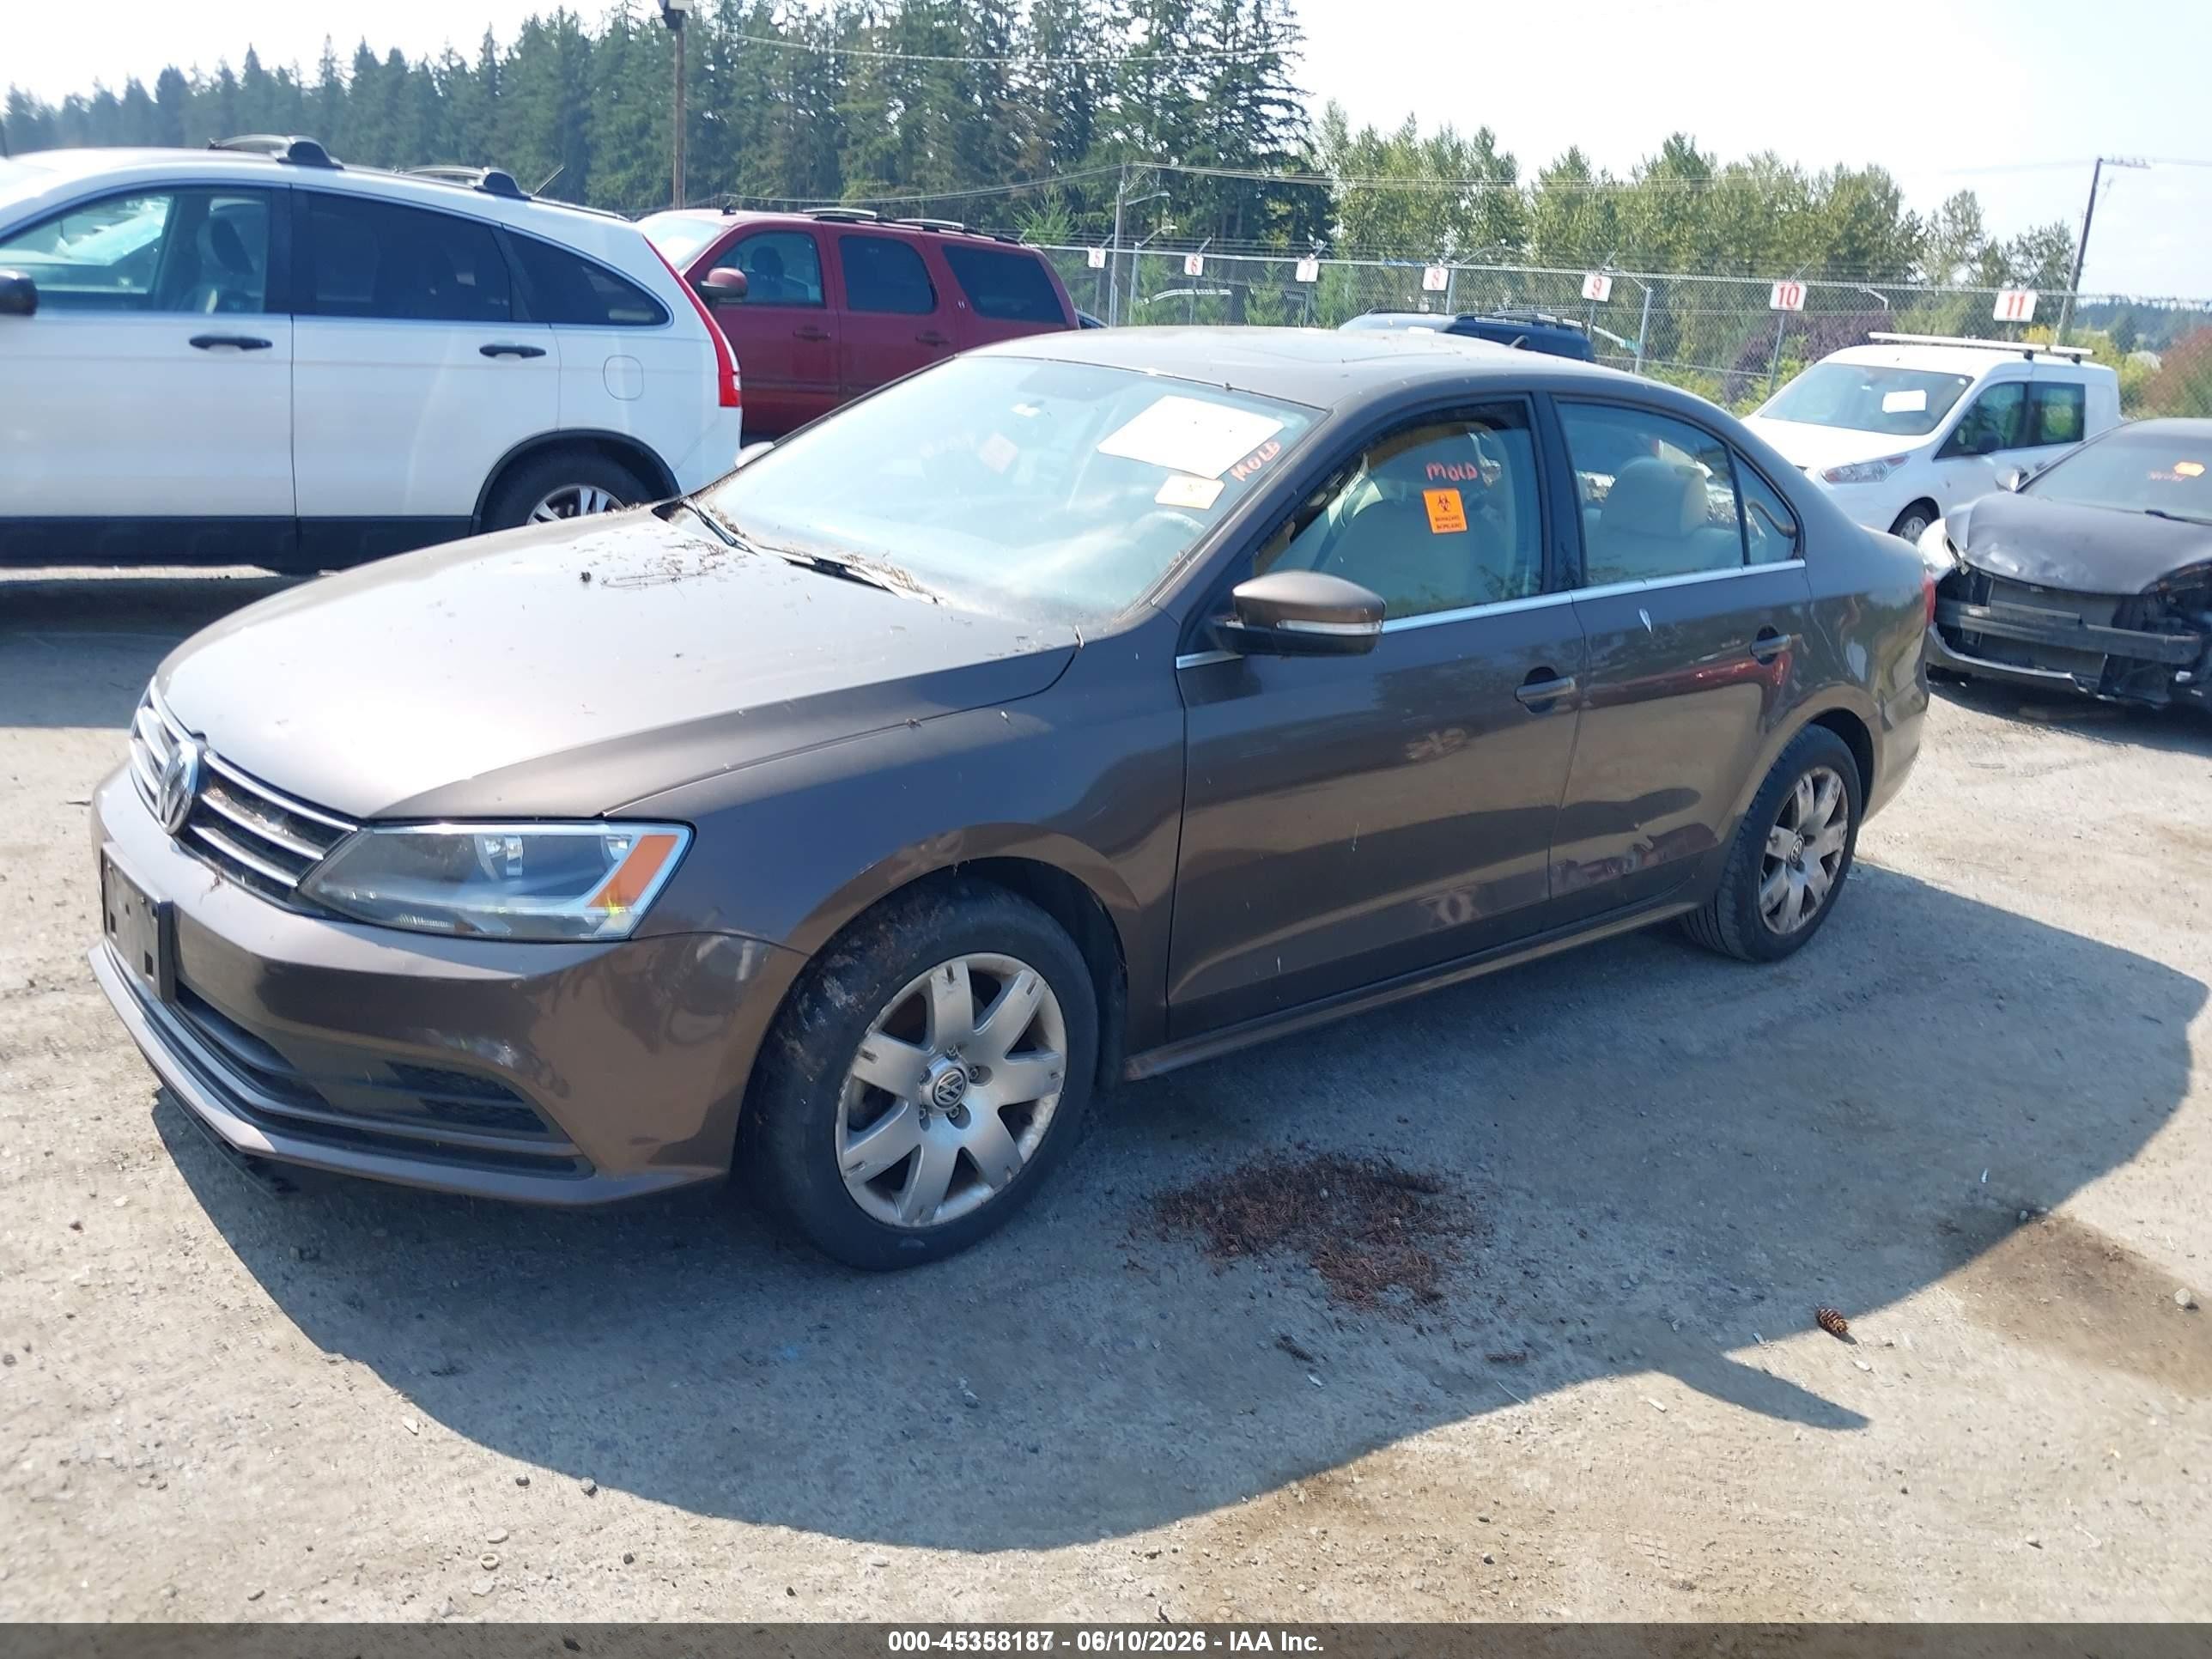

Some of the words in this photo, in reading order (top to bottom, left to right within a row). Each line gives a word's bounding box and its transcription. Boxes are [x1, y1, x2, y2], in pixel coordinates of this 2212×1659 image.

[1093, 251, 1101, 267] 5
[1190, 257, 1199, 275] 6
[1302, 261, 1312, 281] 7
[1431, 269, 1442, 289] 8
[1590, 277, 1602, 297] 9
[1778, 285, 1800, 307] 10
[2007, 295, 2025, 317] 11
